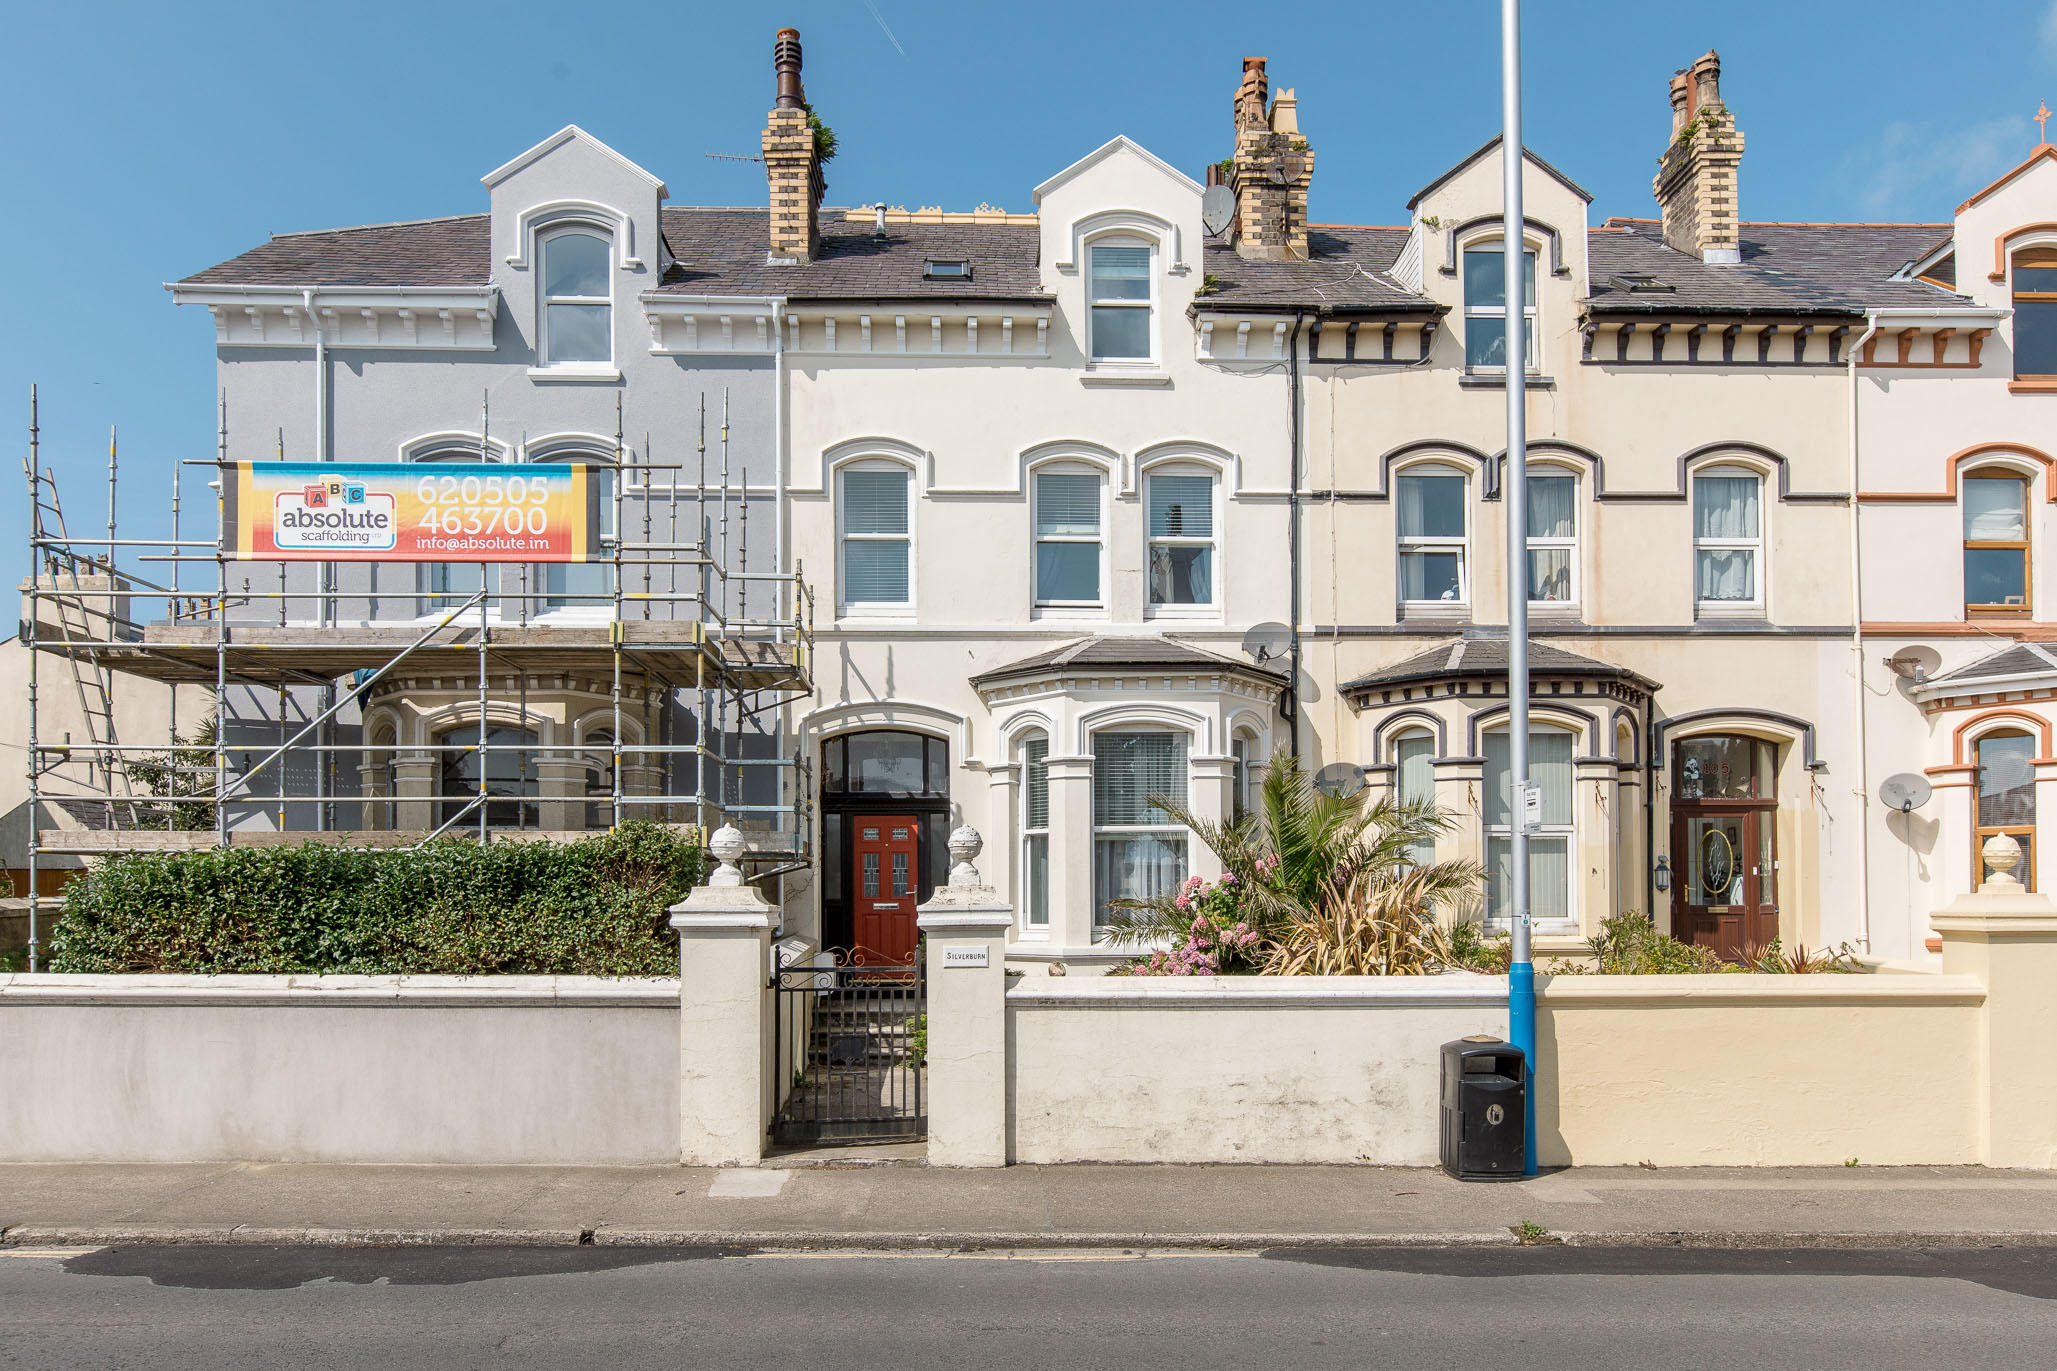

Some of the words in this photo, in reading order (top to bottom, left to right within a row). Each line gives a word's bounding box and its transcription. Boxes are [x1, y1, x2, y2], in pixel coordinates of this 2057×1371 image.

[417, 475, 549, 505] 620505
[282, 507, 388, 529] absolute
[418, 506, 548, 535] 463700
[301, 530, 370, 544] scaffolding
[416, 536, 549, 551] info@absolute.im
[946, 952, 986, 960] SILVERBURN
